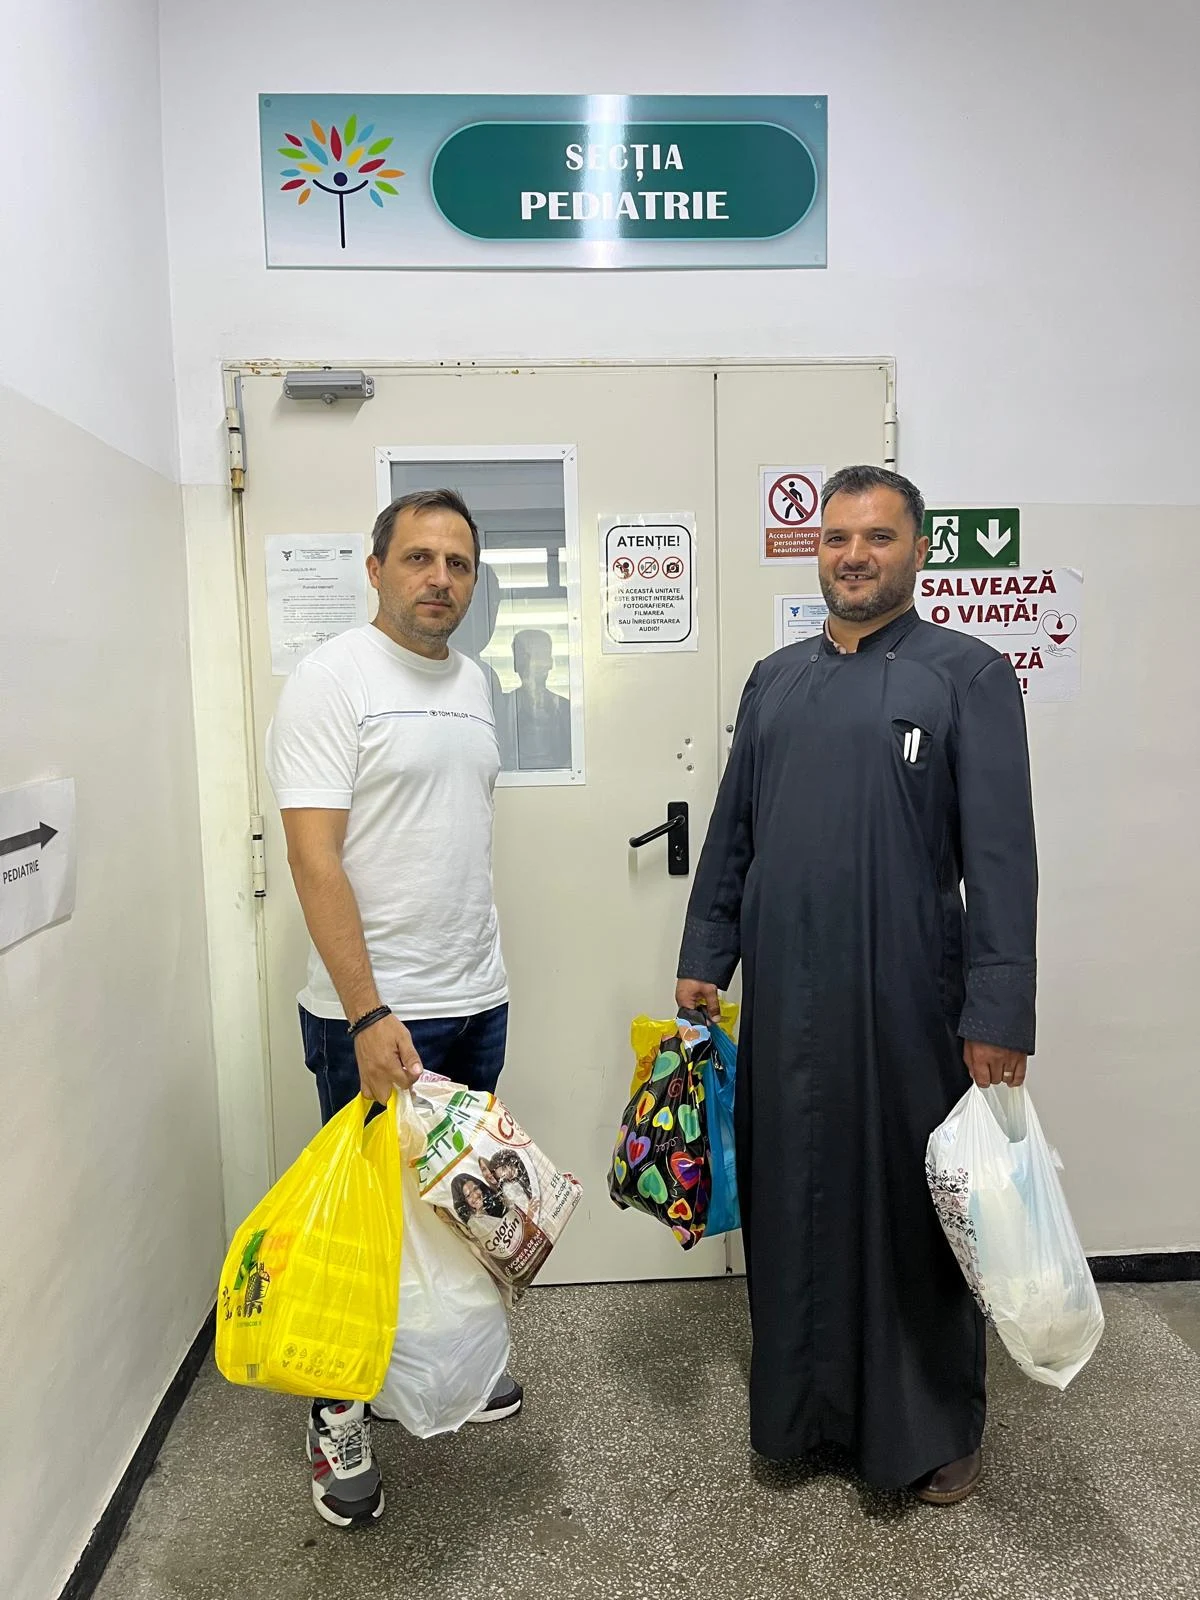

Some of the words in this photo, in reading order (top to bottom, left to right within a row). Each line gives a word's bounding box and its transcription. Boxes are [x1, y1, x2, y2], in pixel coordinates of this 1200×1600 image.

[565, 143, 684, 182] SECȚIA
[521, 191, 730, 220] PEDIATRIE
[617, 535, 680, 550] ATENȚIE!
[768, 531, 793, 539] Accesul
[773, 539, 814, 547] persoanelor
[921, 569, 1057, 597] SALVEAZĂ
[931, 605, 950, 624] O
[958, 597, 1038, 628] VIAȚĂ!
[3, 859, 39, 885] PEDIATRIE
[485, 1218, 510, 1252] Color
[503, 1216, 520, 1250] Soin
